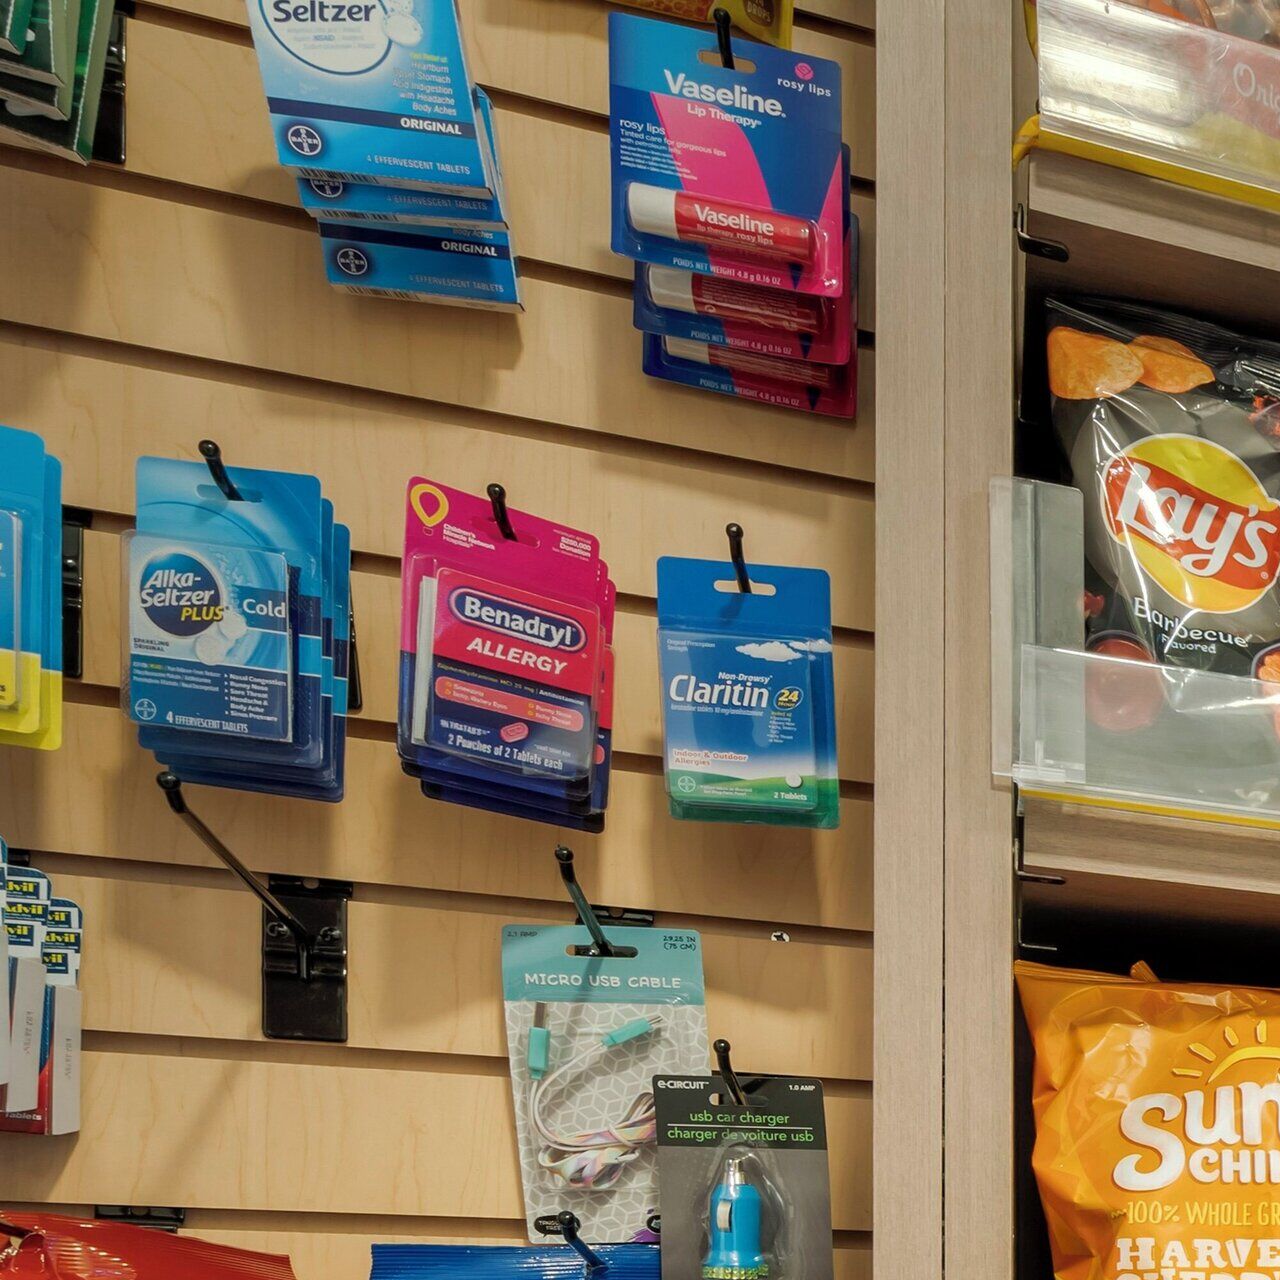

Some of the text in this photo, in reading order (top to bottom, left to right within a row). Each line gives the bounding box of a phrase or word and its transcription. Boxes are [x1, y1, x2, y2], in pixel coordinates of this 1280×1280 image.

[272, 0, 376, 23] Seltzer
[663, 68, 788, 119] Vaseline
[777, 76, 832, 98] rosy lips
[400, 117, 463, 135] ORIGINAL
[686, 103, 762, 129] Lip Therapy
[374, 154, 471, 175] EFFERVESCENT TABLETS
[694, 203, 775, 238] Vaseline
[441, 240, 498, 257] ORIGINAL
[1115, 462, 1280, 578] Lay's
[144, 568, 201, 589] Alka-
[140, 586, 215, 609] Seltzer
[242, 597, 286, 620] Cold
[180, 604, 225, 623] PLUS
[464, 594, 575, 648] Benadryl
[1133, 596, 1249, 649] Barbecue
[466, 636, 568, 676] ALLERGY
[717, 671, 771, 684] Non-Drowsy
[669, 674, 770, 709] Claritin
[777, 688, 800, 703] 24
[525, 972, 682, 990] MICRO USB CABLE
[788, 1084, 799, 1092] 1.0
[689, 1110, 790, 1127] usb car charger
[667, 1127, 815, 1144] charger de voiture usb
[1125, 1200, 1181, 1227] 100%
[1184, 1201, 1254, 1228] WHOLE
